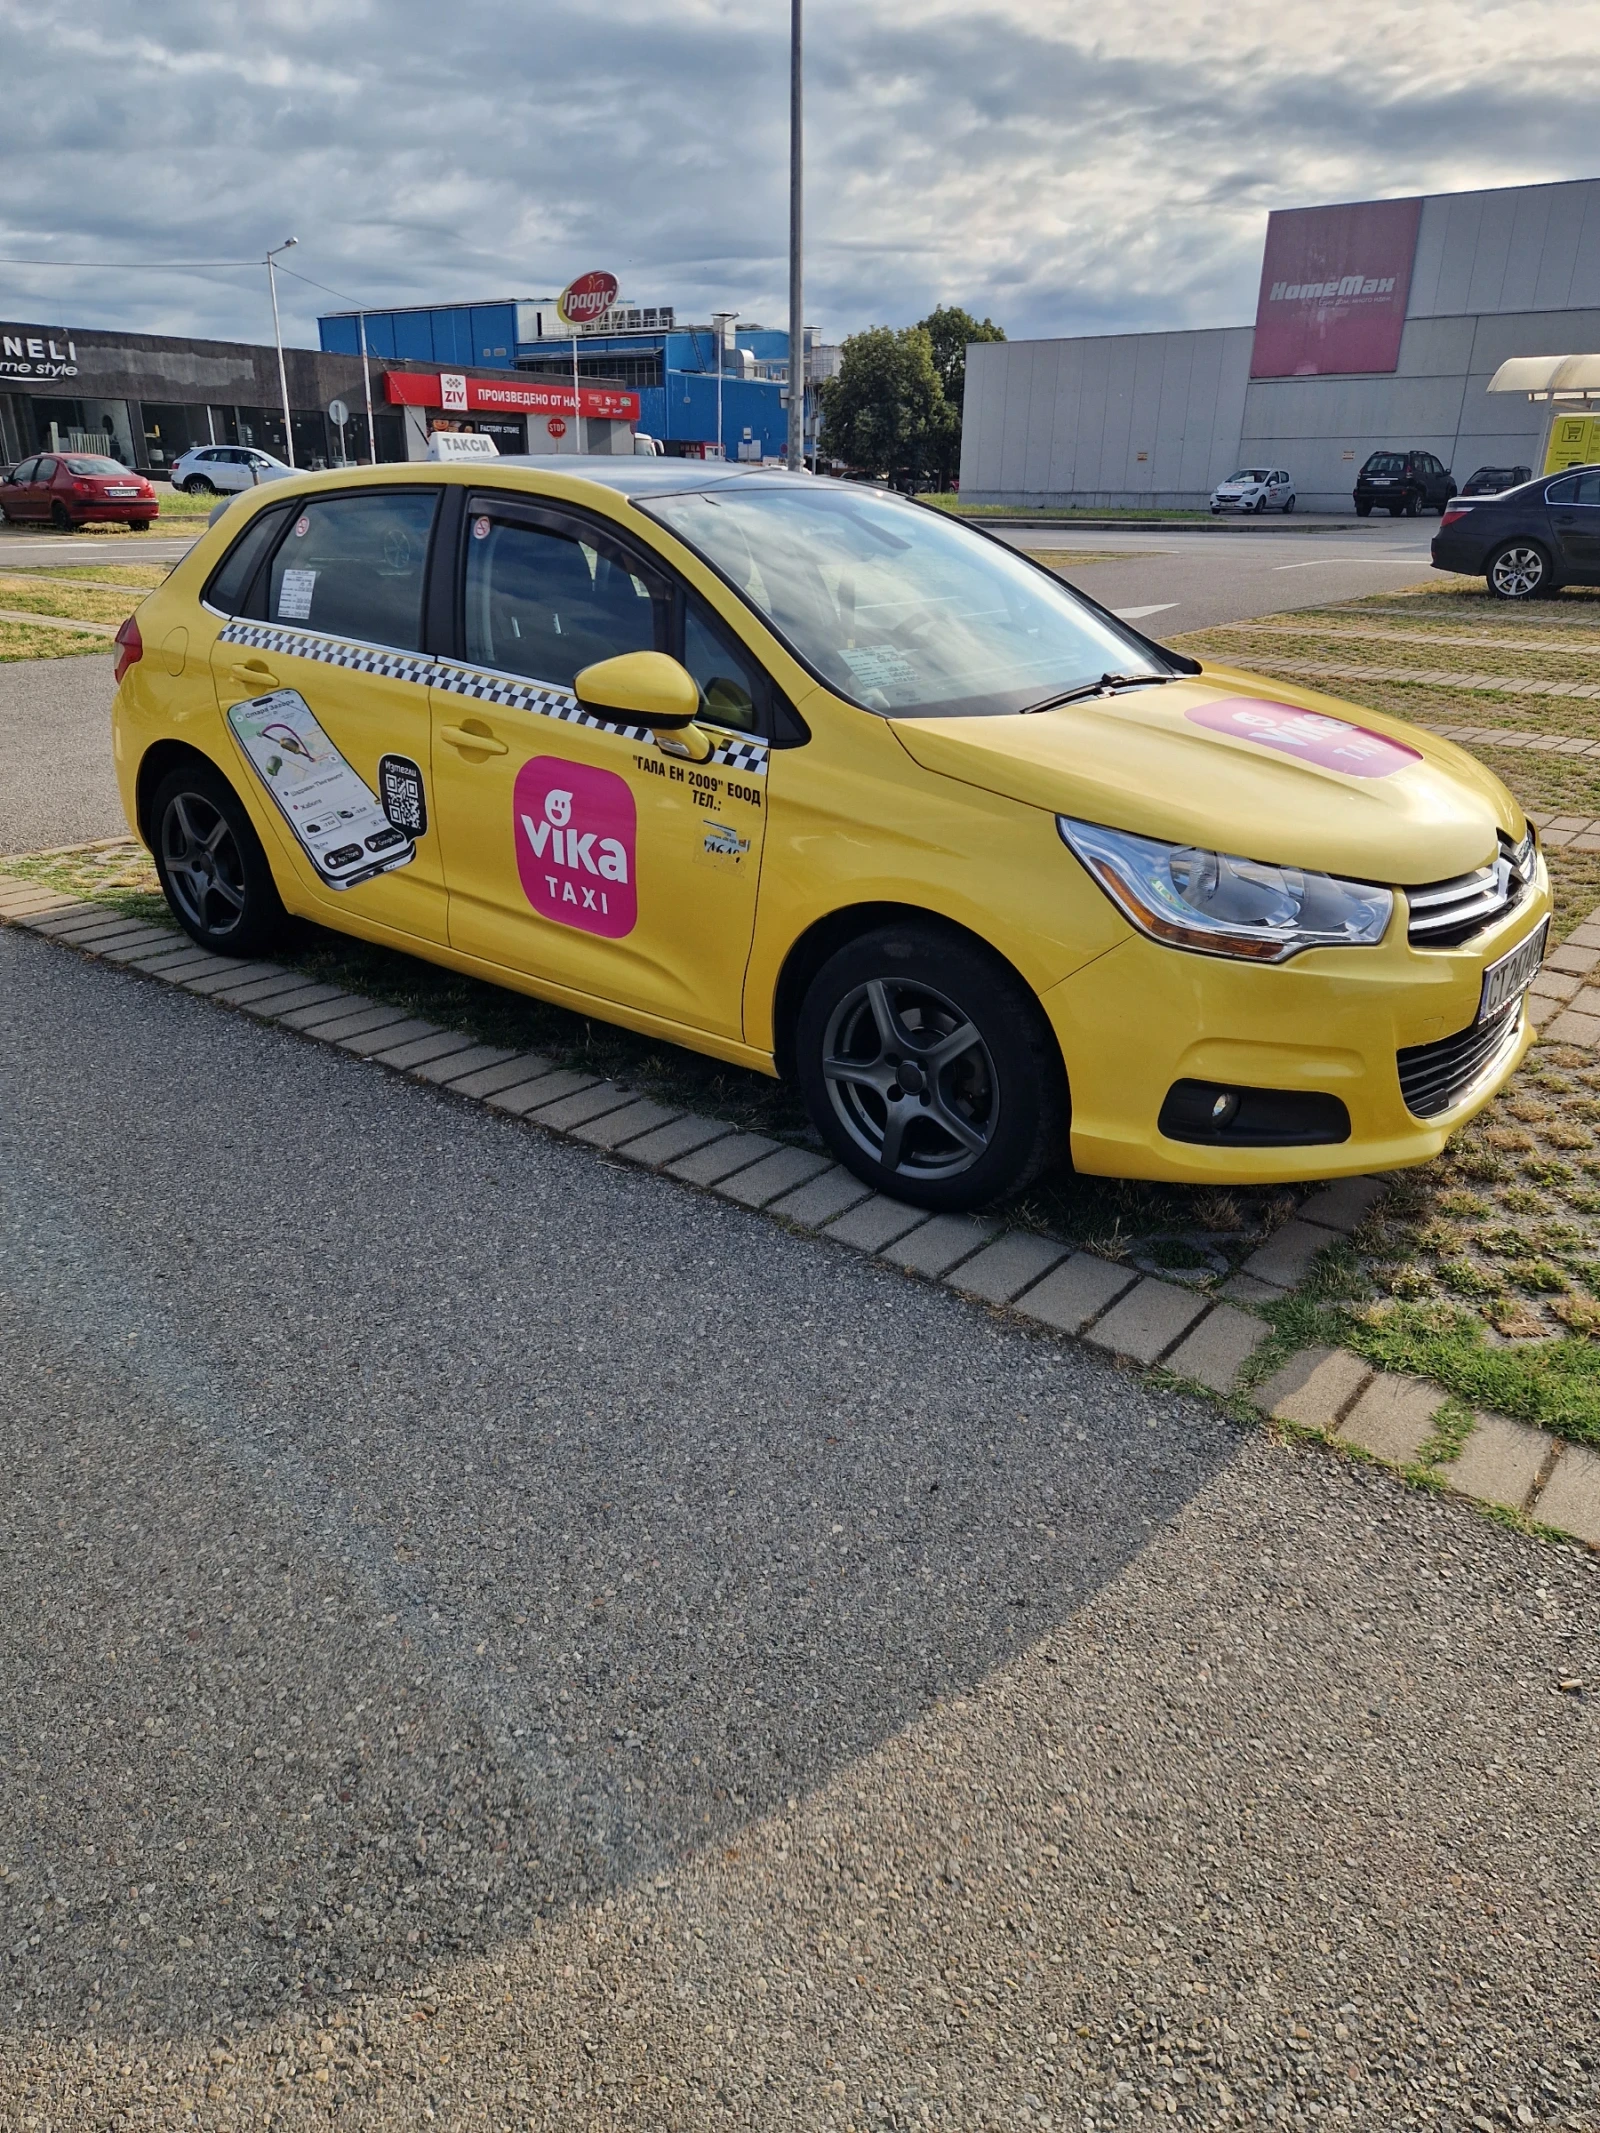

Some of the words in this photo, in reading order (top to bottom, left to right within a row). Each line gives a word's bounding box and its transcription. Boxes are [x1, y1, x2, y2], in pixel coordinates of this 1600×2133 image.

[1269, 275, 1396, 301] HomeMax
[563, 290, 614, 317] Градус
[36, 362, 78, 378] style
[444, 390, 465, 403] ZIV
[477, 388, 549, 406] ПРОИЗВЕДЕНО
[550, 394, 562, 406] ОТ
[549, 423, 565, 432] STOP
[442, 438, 491, 453] ТАКСИ
[633, 754, 666, 777] "ГАЛА
[669, 766, 684, 783] ЕН
[688, 771, 724, 792] 2009"
[727, 782, 761, 808] ЕООД
[692, 789, 722, 812] ТЕЛ.:
[544, 874, 608, 915] TAXI
